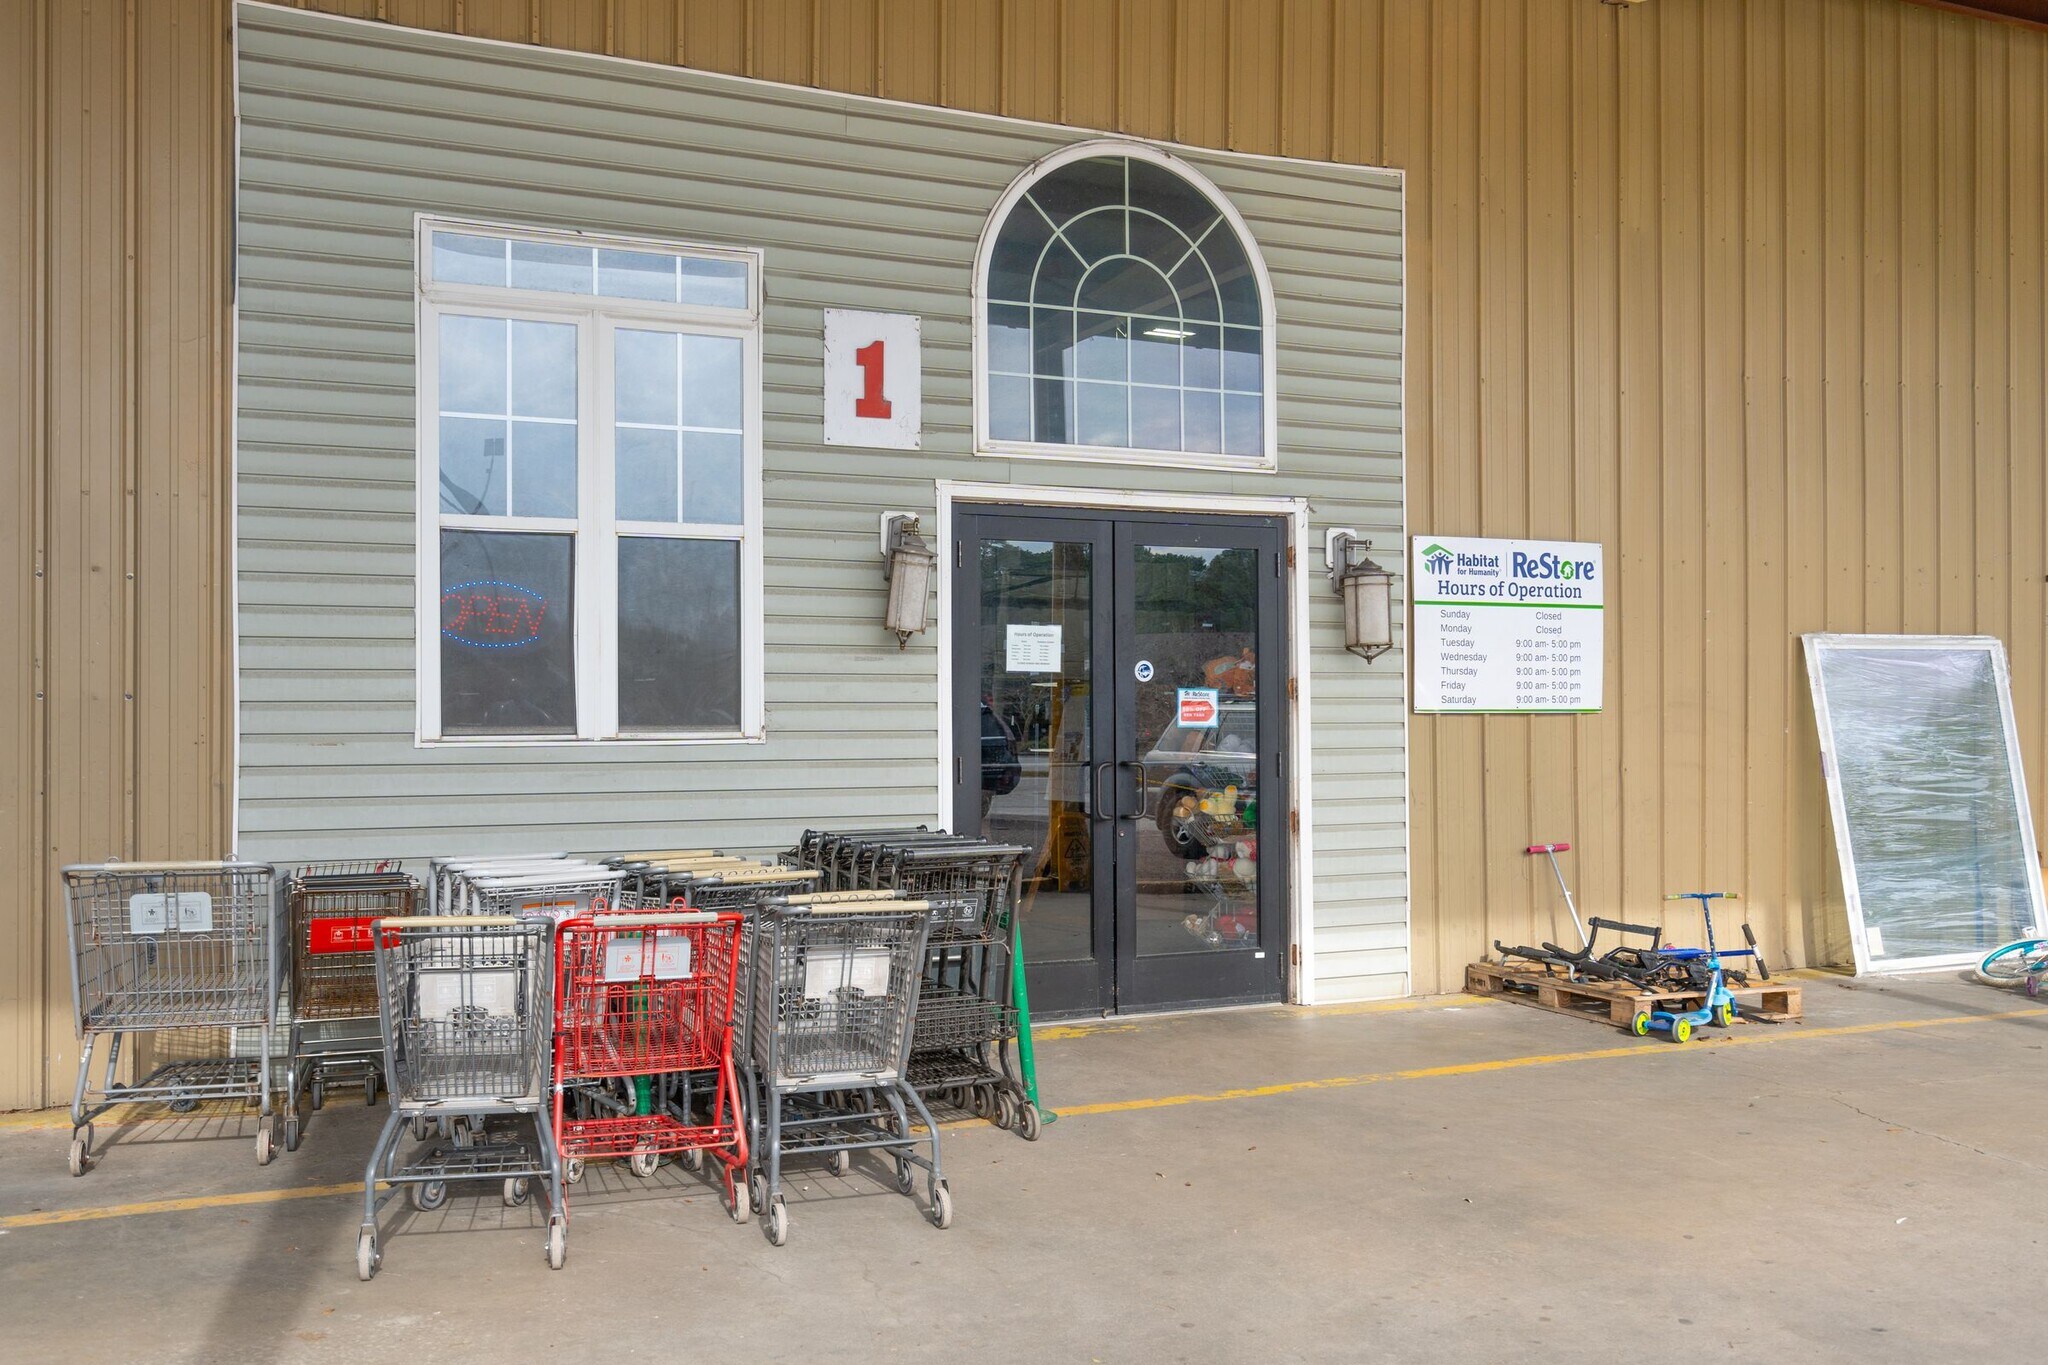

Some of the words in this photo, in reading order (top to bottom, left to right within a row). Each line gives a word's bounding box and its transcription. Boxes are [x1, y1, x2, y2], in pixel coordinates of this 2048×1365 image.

[855, 340, 892, 419] 1
[1457, 553, 1500, 568] Habitat
[1512, 551, 1594, 581] ReStore
[1457, 567, 1467, 576] for
[1468, 567, 1500, 578] Humanity
[1437, 580, 1486, 596] Hours
[1489, 580, 1506, 597] of
[1508, 582, 1582, 601] Operation
[1440, 609, 1471, 620] Sunday
[1535, 611, 1562, 620] Closed
[1440, 624, 1472, 634] Monday
[1535, 625, 1562, 634] Closed
[1441, 638, 1475, 649] Tuesday
[1516, 639, 1533, 648] 9:00
[1551, 640, 1568, 648] 5:00
[1569, 641, 1581, 650] pm
[1440, 652, 1487, 663] Wednesday
[1516, 653, 1533, 662] 9:00
[1551, 654, 1568, 662] 5:00
[1569, 655, 1581, 664] pm
[1441, 666, 1478, 677] Thursday
[1516, 667, 1533, 676] 9:00
[1551, 668, 1568, 676] 5:00
[1569, 669, 1581, 678] pm
[1441, 681, 1466, 691] Friday
[1516, 681, 1533, 690] 9:00
[1551, 682, 1568, 690] 5:00
[1569, 683, 1581, 692] pm
[1441, 695, 1477, 706] Saturday
[1516, 695, 1533, 704] 9:00
[1551, 696, 1568, 704] 5:00
[1569, 697, 1581, 706] pm
